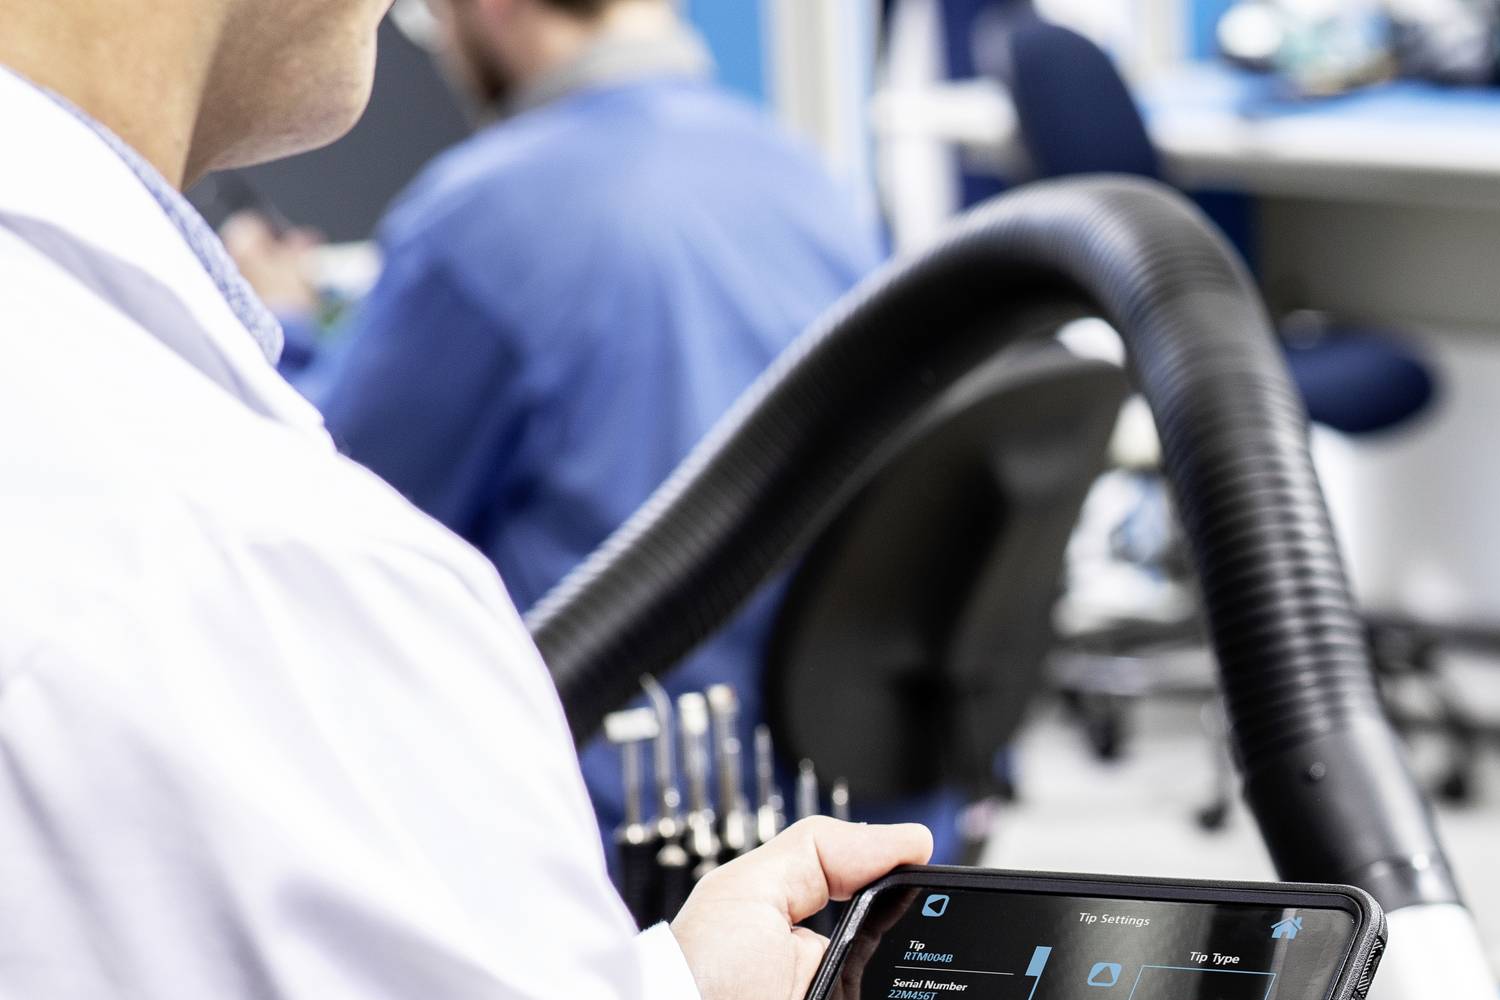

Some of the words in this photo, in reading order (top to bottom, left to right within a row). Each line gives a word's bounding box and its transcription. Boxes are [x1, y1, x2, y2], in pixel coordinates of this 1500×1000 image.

[1079, 912, 1097, 925] Tip
[1100, 914, 1150, 928] Settings
[909, 940, 925, 951] Tip
[903, 951, 953, 963] RTM004B
[1189, 951, 1208, 964] Tip
[1212, 952, 1240, 966] Type
[892, 978, 923, 989] Serial
[924, 980, 968, 992] Number
[887, 989, 939, 1000] 22M456T
